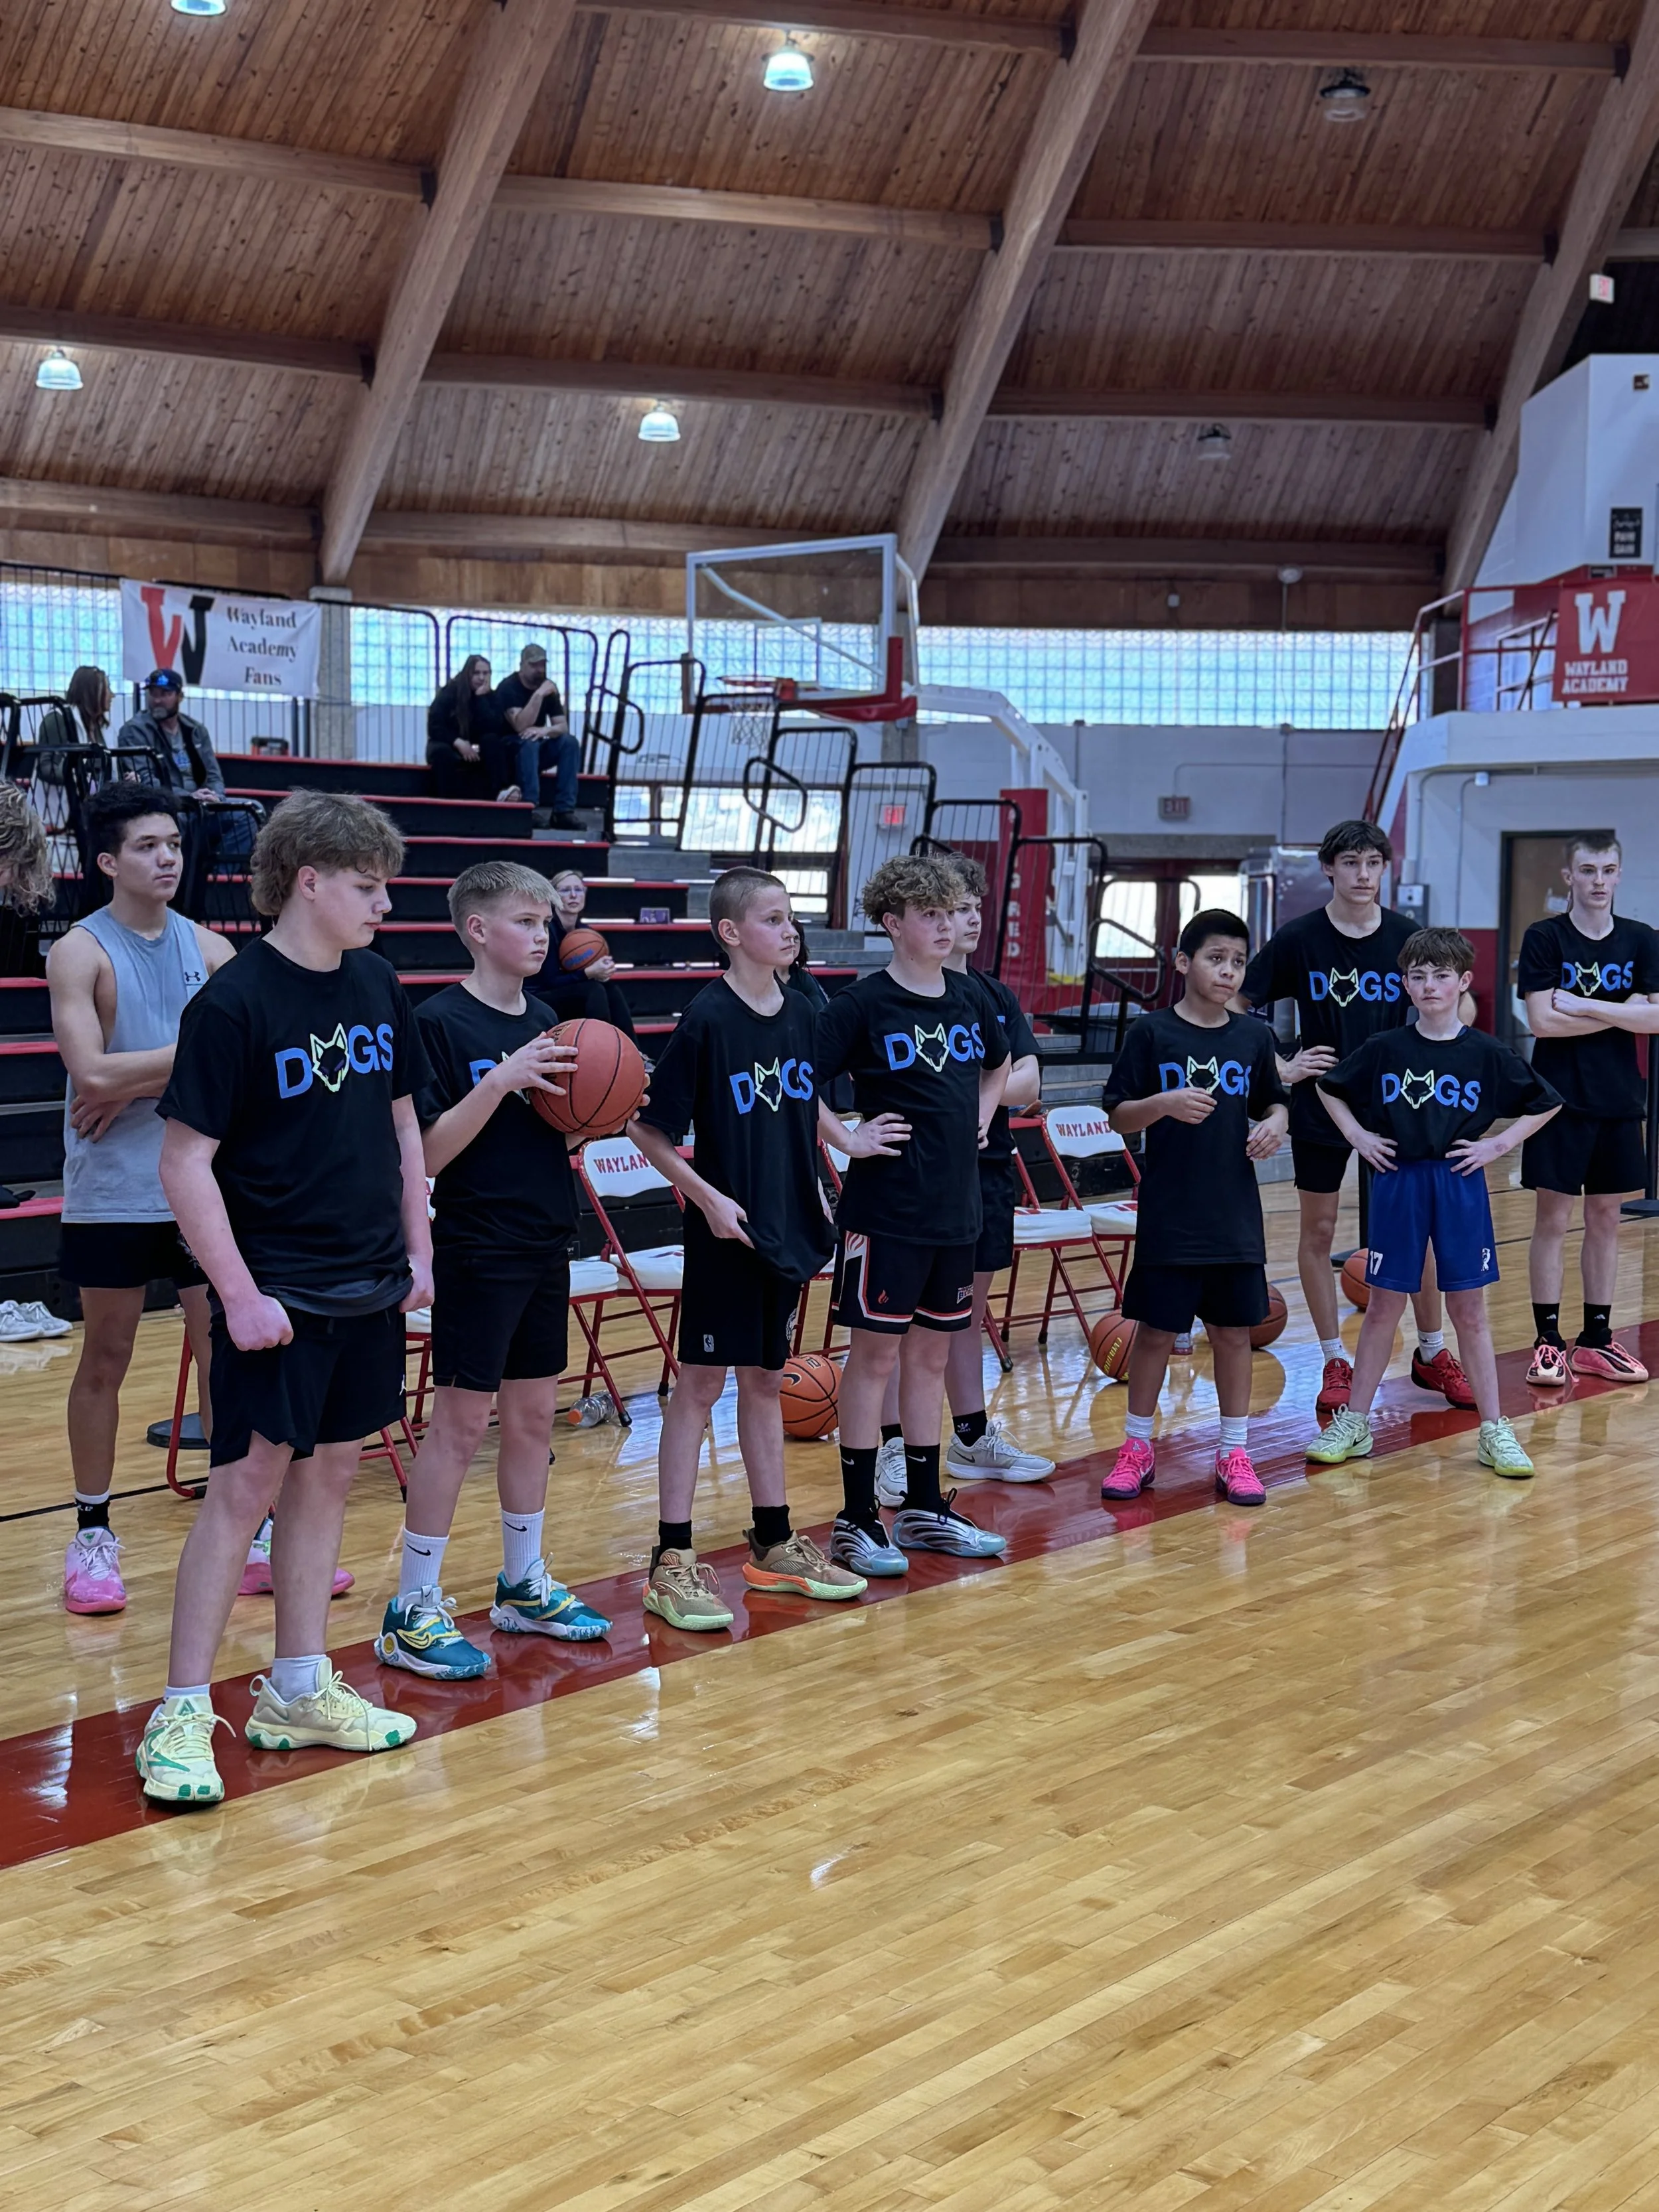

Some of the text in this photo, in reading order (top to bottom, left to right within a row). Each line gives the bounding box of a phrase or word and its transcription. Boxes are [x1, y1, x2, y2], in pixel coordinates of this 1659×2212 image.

[226, 606, 297, 630] Wayland
[1574, 589, 1626, 654] W
[141, 586, 216, 685] W
[227, 635, 298, 663] Academy
[244, 666, 282, 686] Fans
[1564, 658, 1628, 676] WAYLAND
[1561, 676, 1628, 695] ACADEMY
[593, 1153, 649, 1174] WAYLAN
[1370, 1250, 1384, 1276] 17
